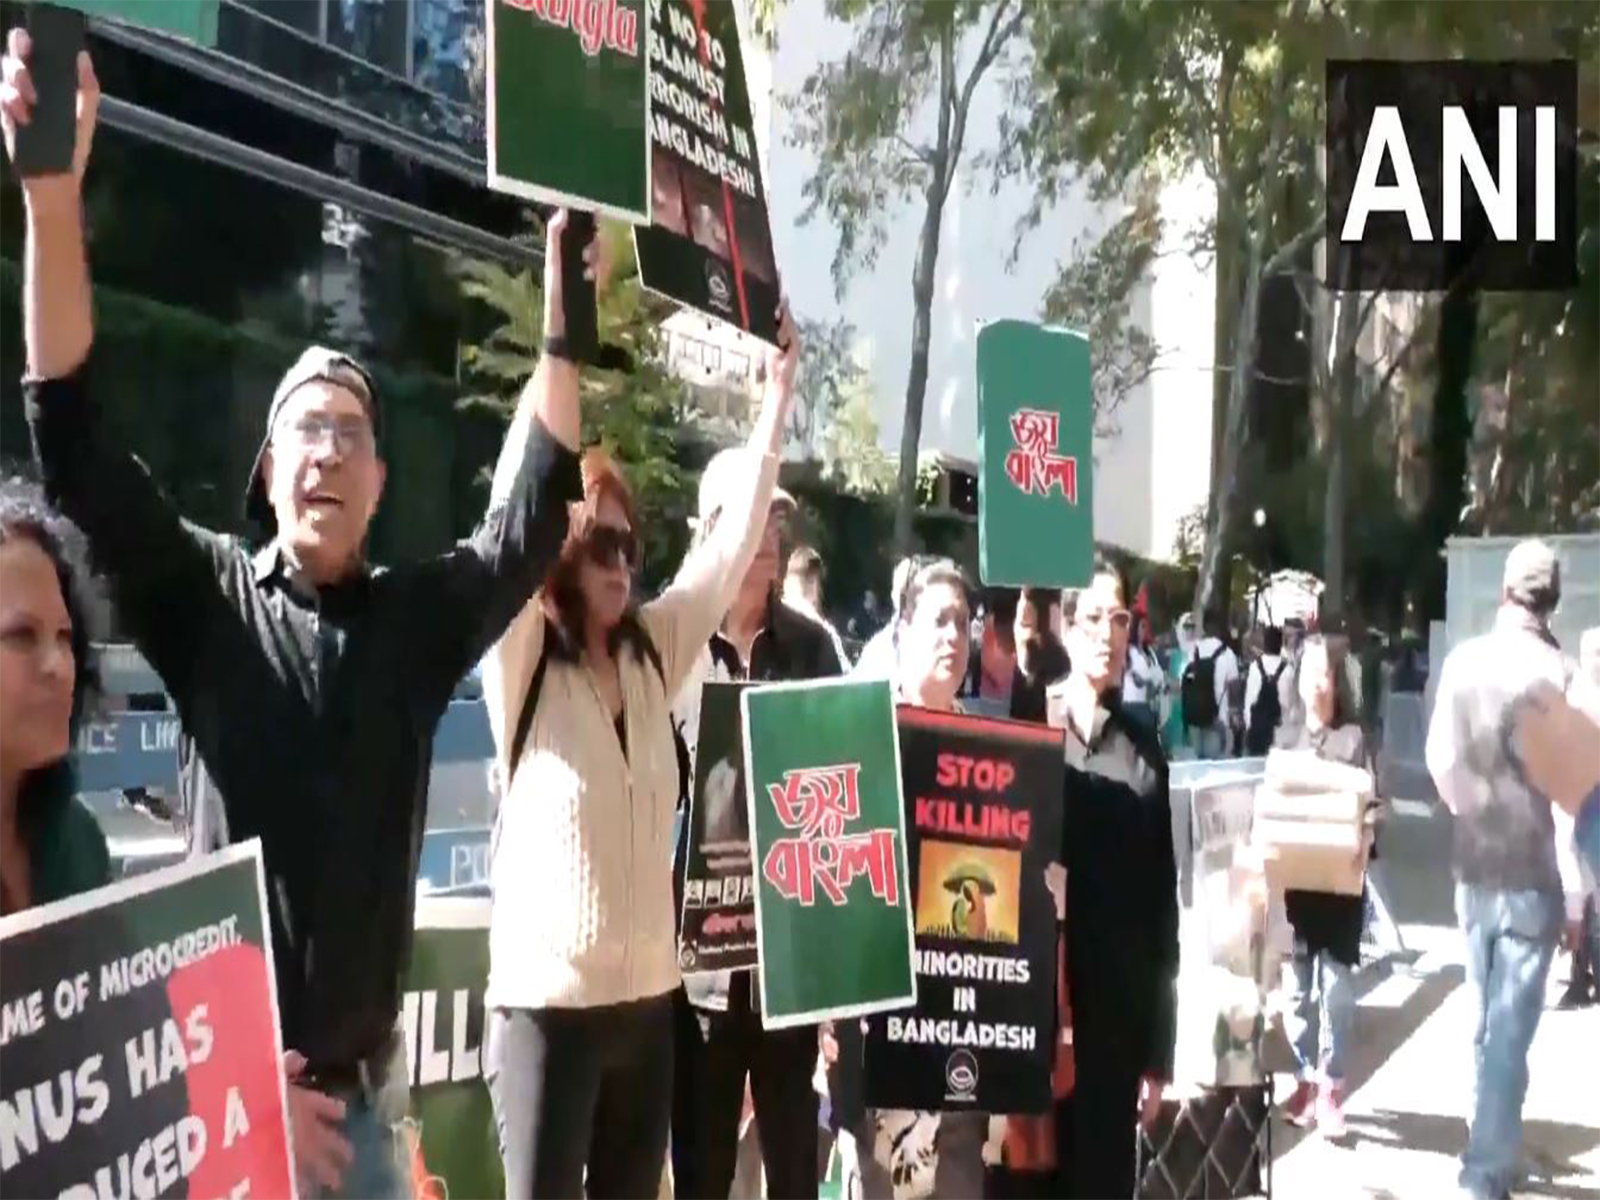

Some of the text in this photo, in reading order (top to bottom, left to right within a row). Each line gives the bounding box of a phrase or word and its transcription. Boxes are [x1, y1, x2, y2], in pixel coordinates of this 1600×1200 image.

[503, 0, 638, 56] angla
[668, 2, 697, 49] NO
[700, 29, 726, 68] TO
[731, 123, 751, 159] IN
[1005, 449, 1078, 506] বাংলা
[765, 762, 862, 839] জয়
[936, 753, 1015, 792] STOP
[915, 796, 1031, 842] KILLING
[762, 828, 899, 907] বাংলা
[0, 989, 46, 1047] ME
[54, 971, 90, 1020] OF
[953, 987, 976, 1012] IN
[887, 1016, 1037, 1051] BANGLADESH
[0, 1002, 214, 1172] NUS HAS
[222, 1086, 249, 1149] A
